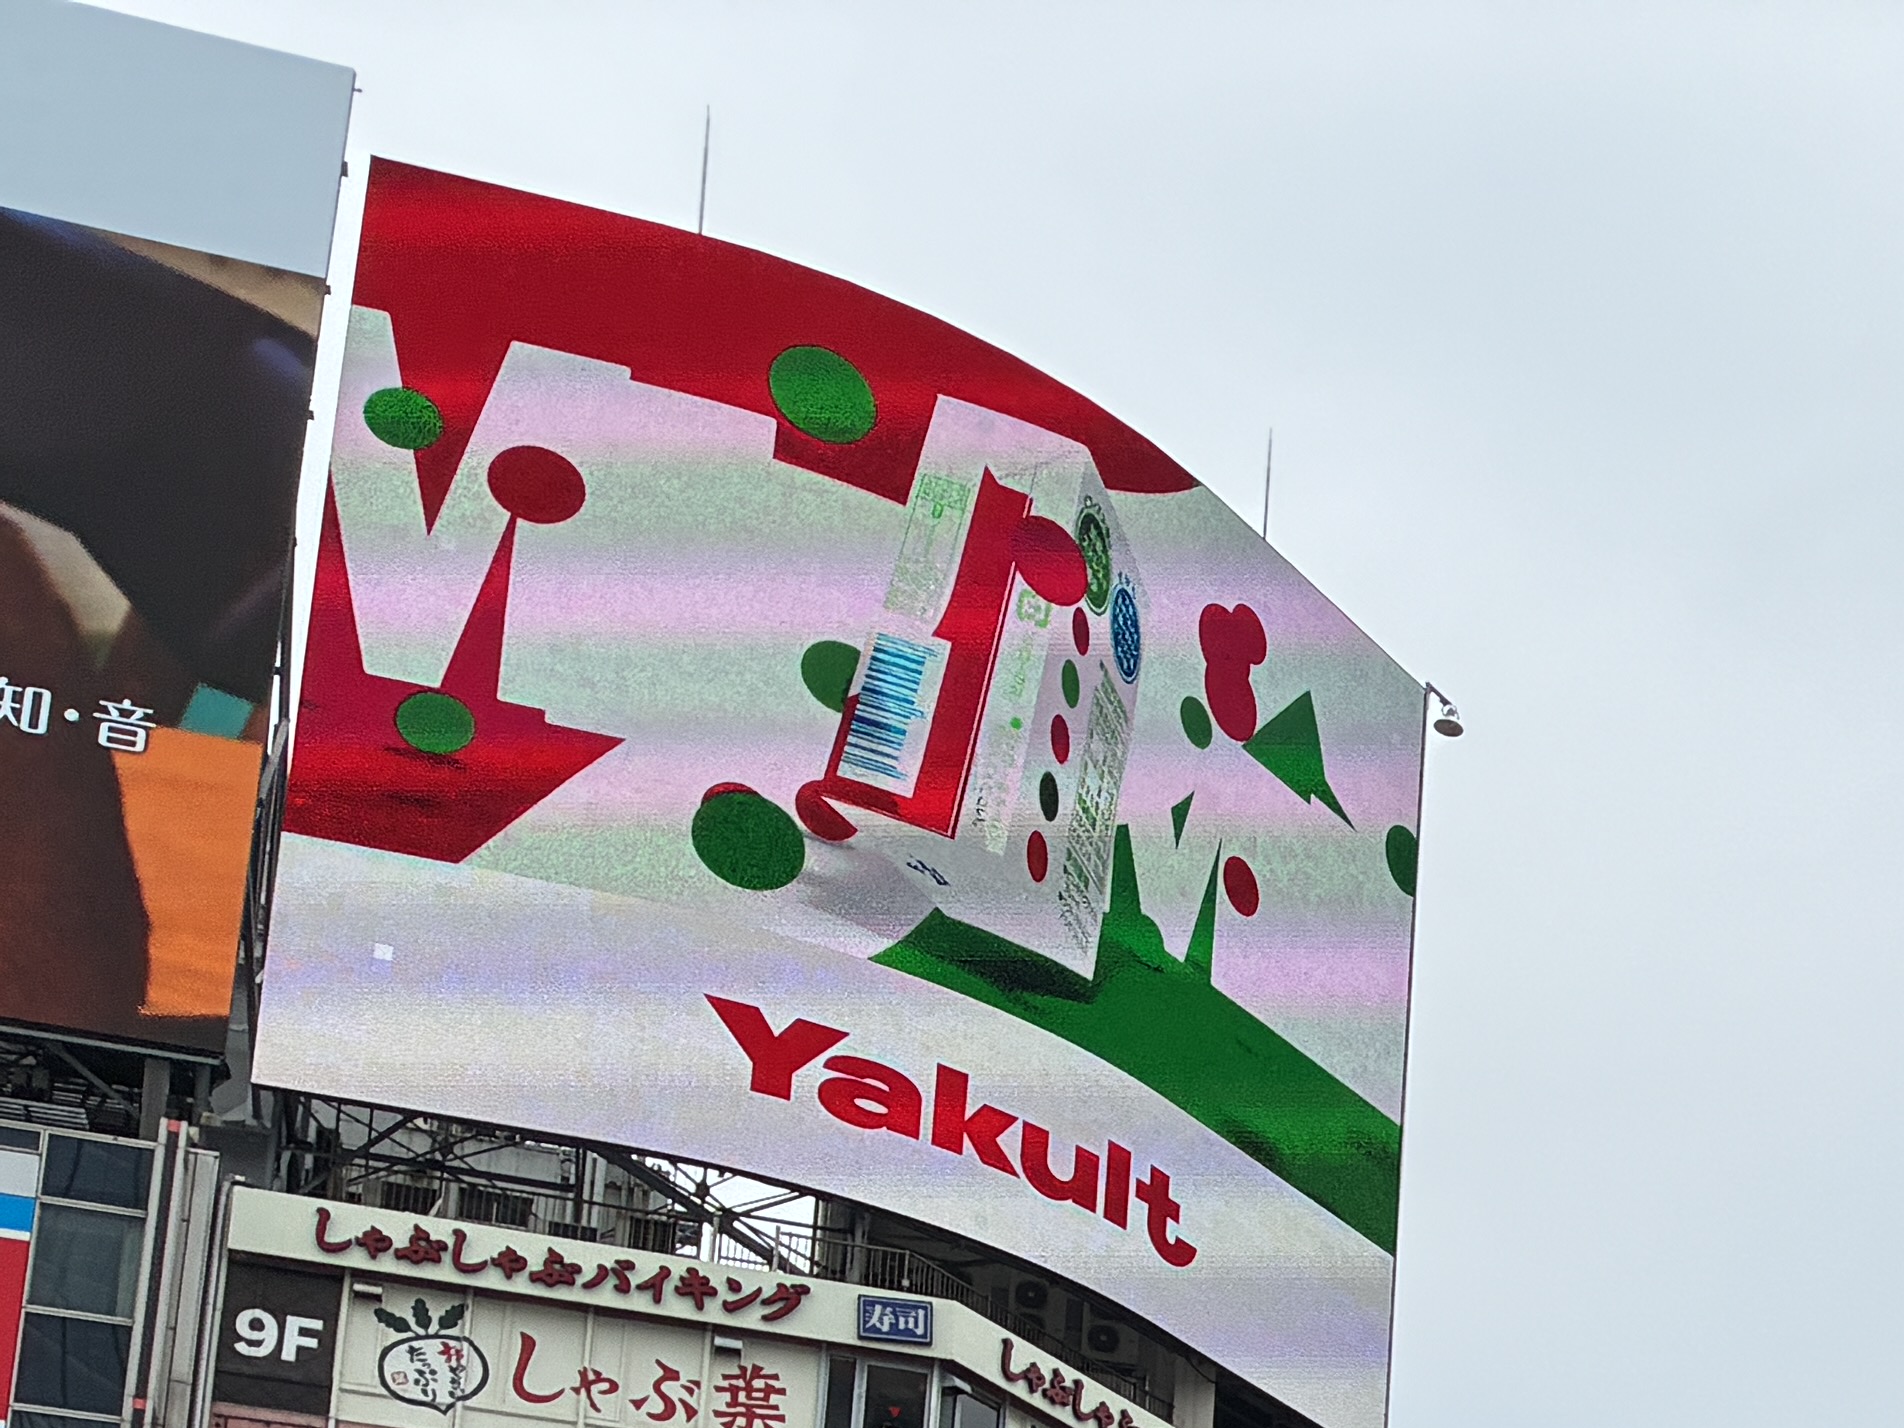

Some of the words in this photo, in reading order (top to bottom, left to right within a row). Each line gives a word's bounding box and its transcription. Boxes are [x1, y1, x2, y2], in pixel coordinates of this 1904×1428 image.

[703, 993, 1199, 1267] Yakult
[315, 1206, 811, 1322] しゃぶしゃぶバイキング
[232, 1306, 324, 1364] 9F
[863, 1302, 927, 1338] 寿司
